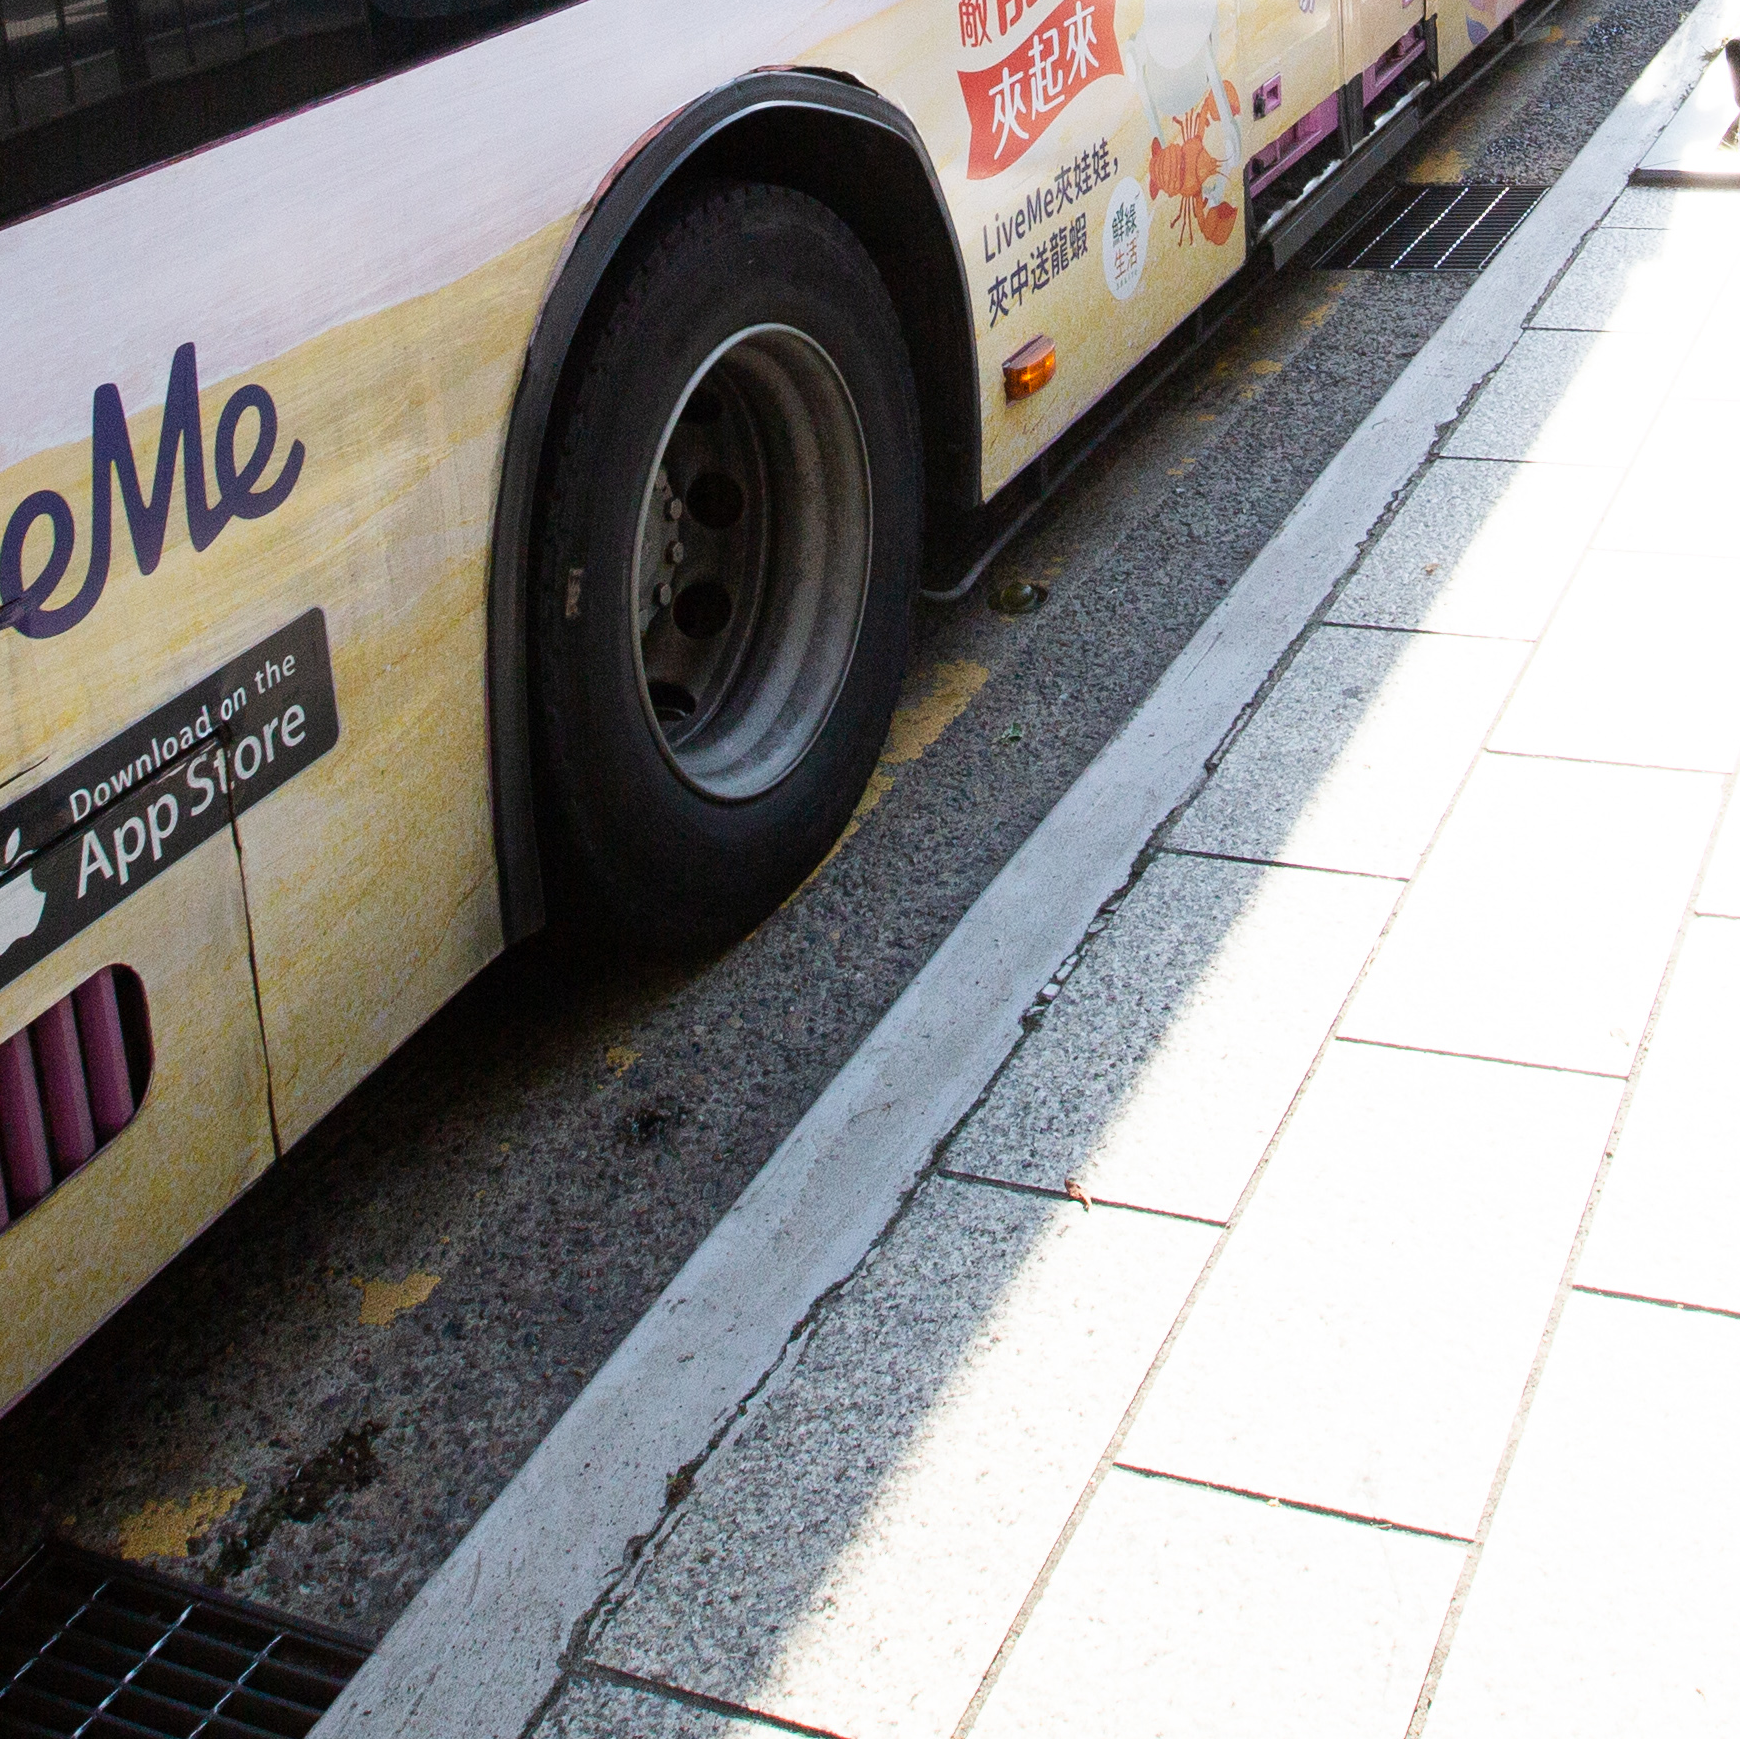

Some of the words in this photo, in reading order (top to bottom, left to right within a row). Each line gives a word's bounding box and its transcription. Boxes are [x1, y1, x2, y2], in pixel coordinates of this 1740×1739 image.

[988, 0, 1098, 160] 夾起來
[987, 212, 1089, 329] 夾中送龍蝦
[68, 704, 213, 823] Download
[220, 686, 248, 722] on
[253, 654, 296, 695] the
[77, 793, 179, 900] App
[186, 704, 306, 817] Store
